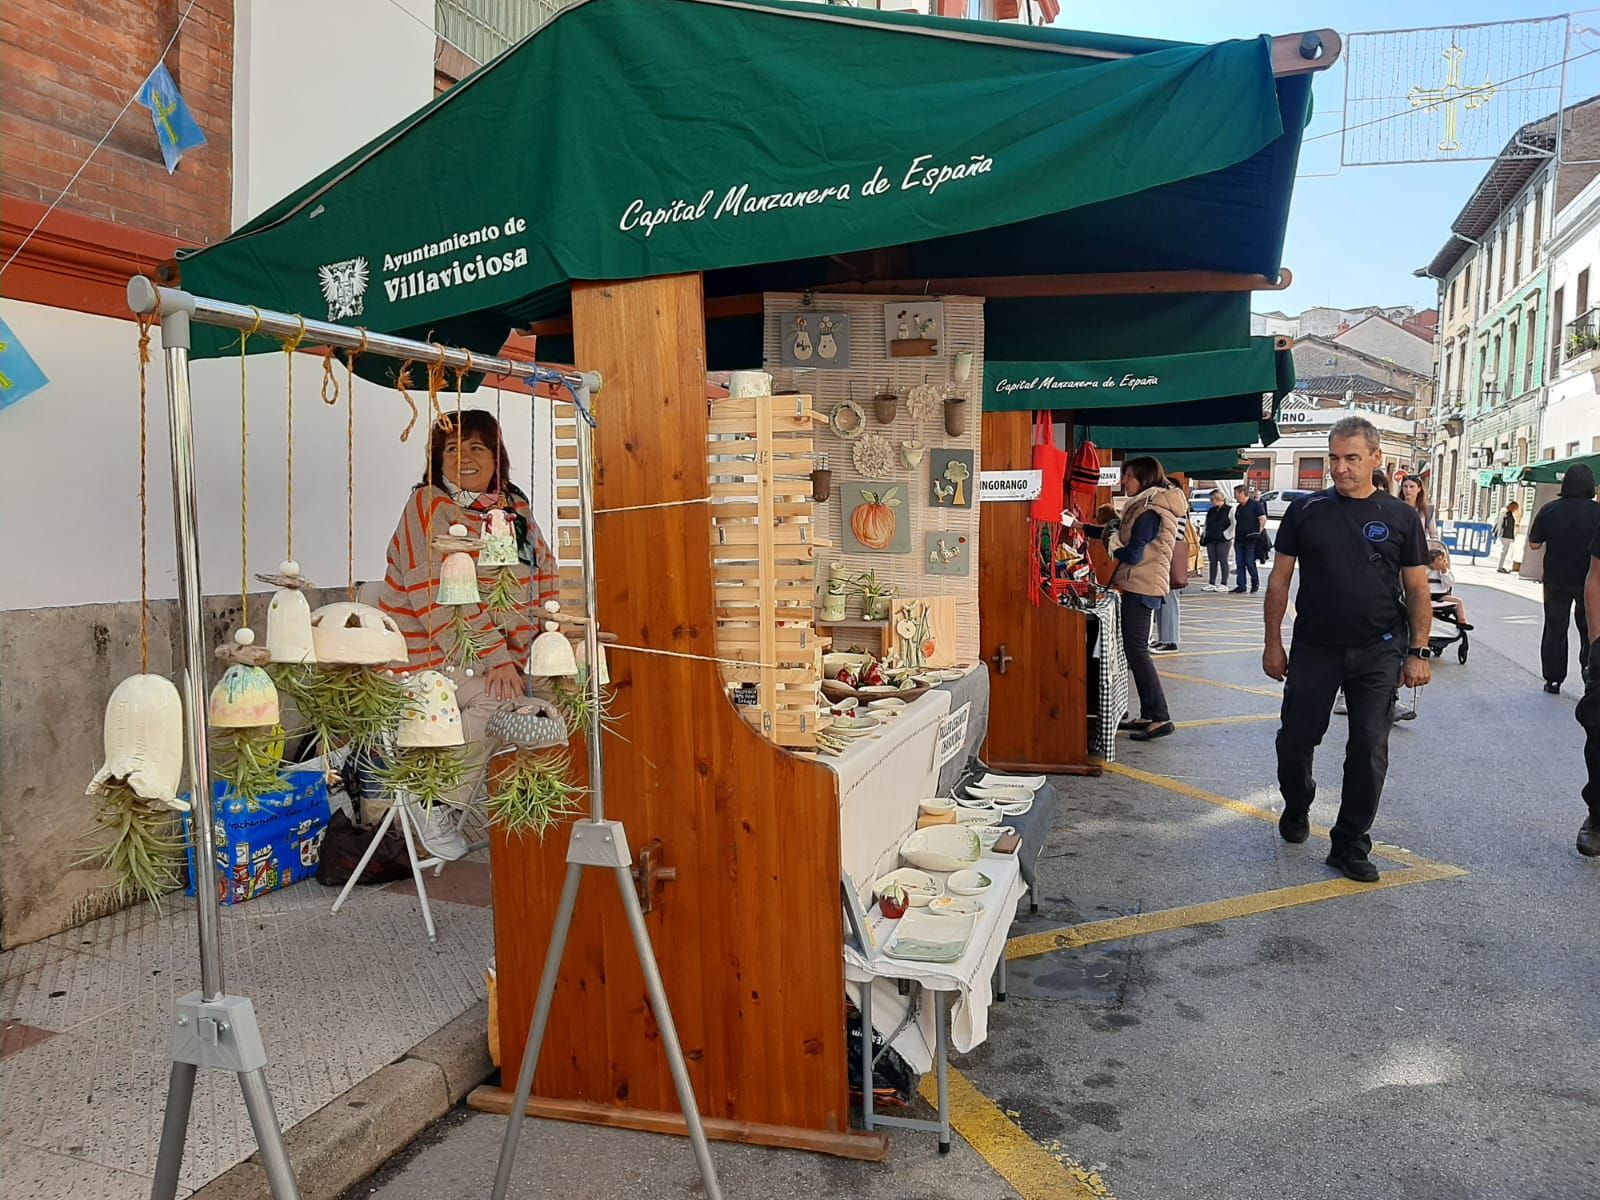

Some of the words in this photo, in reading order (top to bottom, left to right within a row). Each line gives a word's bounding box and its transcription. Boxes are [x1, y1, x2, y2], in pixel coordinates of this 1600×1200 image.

[619, 189, 714, 236] Capital
[713, 183, 851, 220] Manzanera
[861, 166, 891, 197] de
[901, 154, 993, 194] España
[382, 224, 500, 272] Ayuntamiento
[504, 216, 527, 236] de
[383, 247, 528, 303] Villaviciosa
[995, 376, 1039, 395] Capital
[1038, 376, 1098, 390] Manzanera
[1102, 376, 1116, 387] de
[1119, 373, 1159, 391] España
